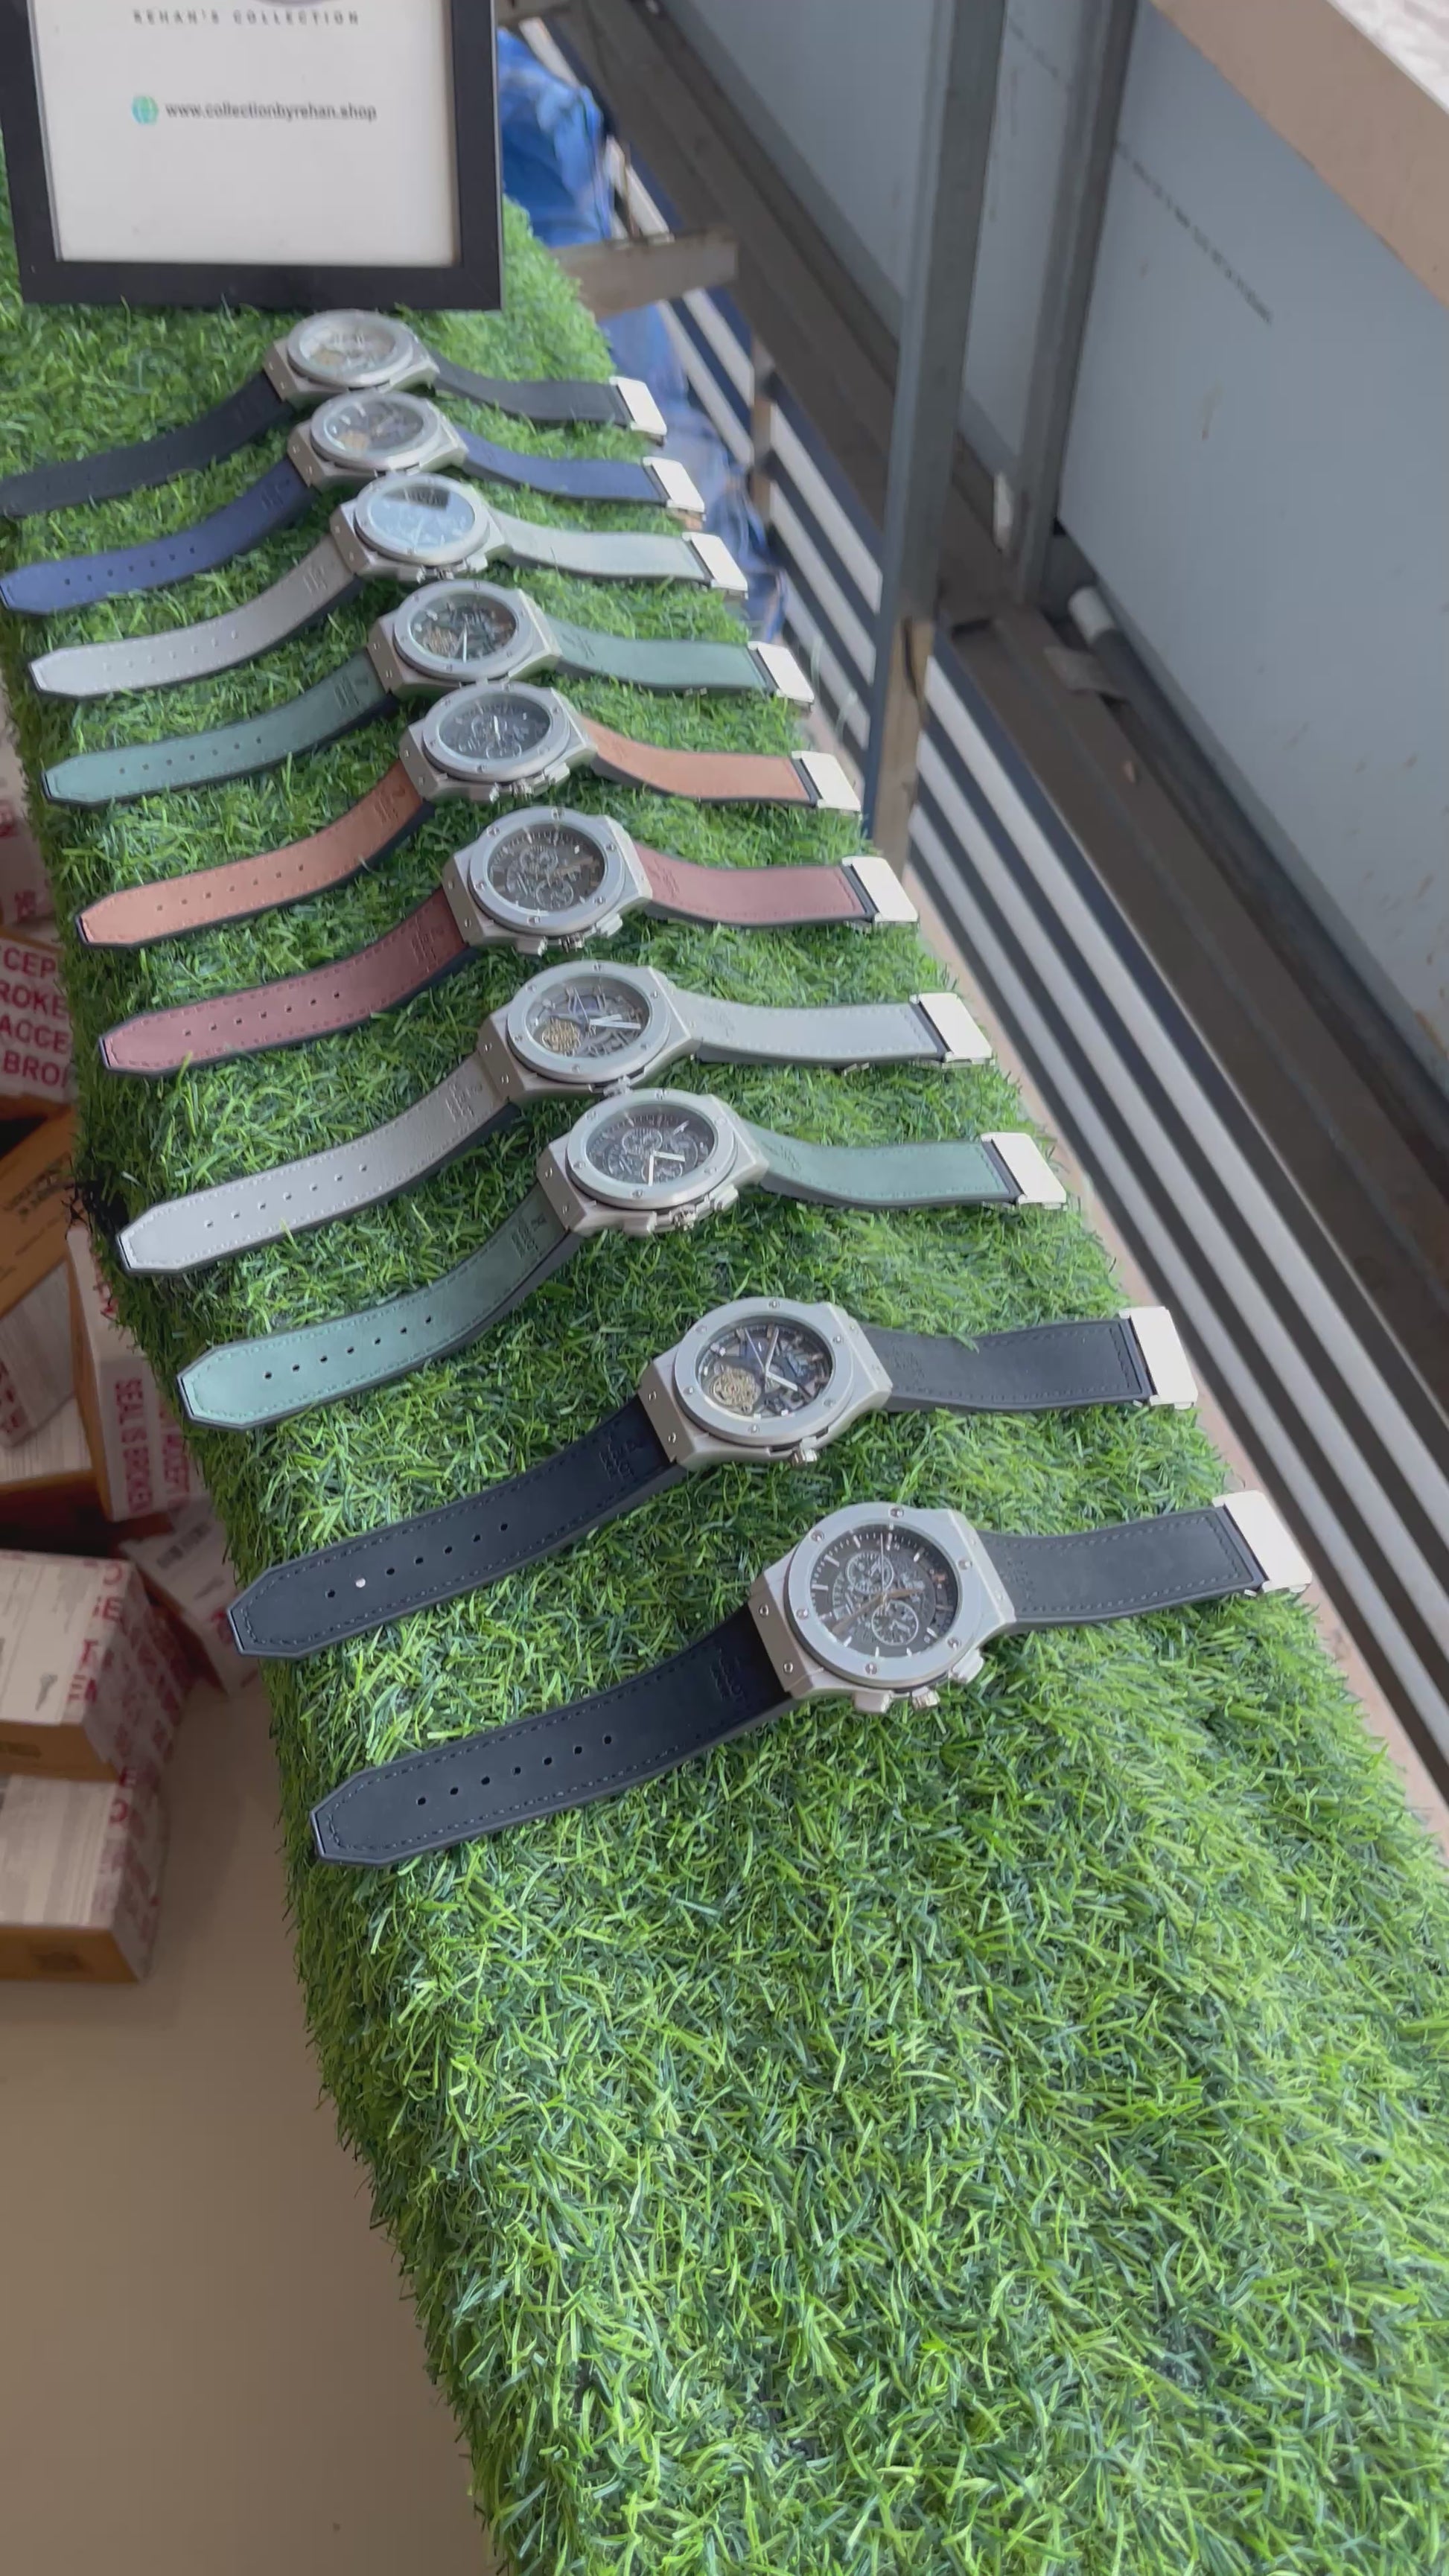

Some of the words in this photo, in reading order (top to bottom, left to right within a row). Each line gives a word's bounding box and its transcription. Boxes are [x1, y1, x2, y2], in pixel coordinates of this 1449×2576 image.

[232, 9, 359, 26] COLLECTION
[165, 101, 378, 123] www.collectionbyrehan.shop
[0, 946, 57, 978] CEP
